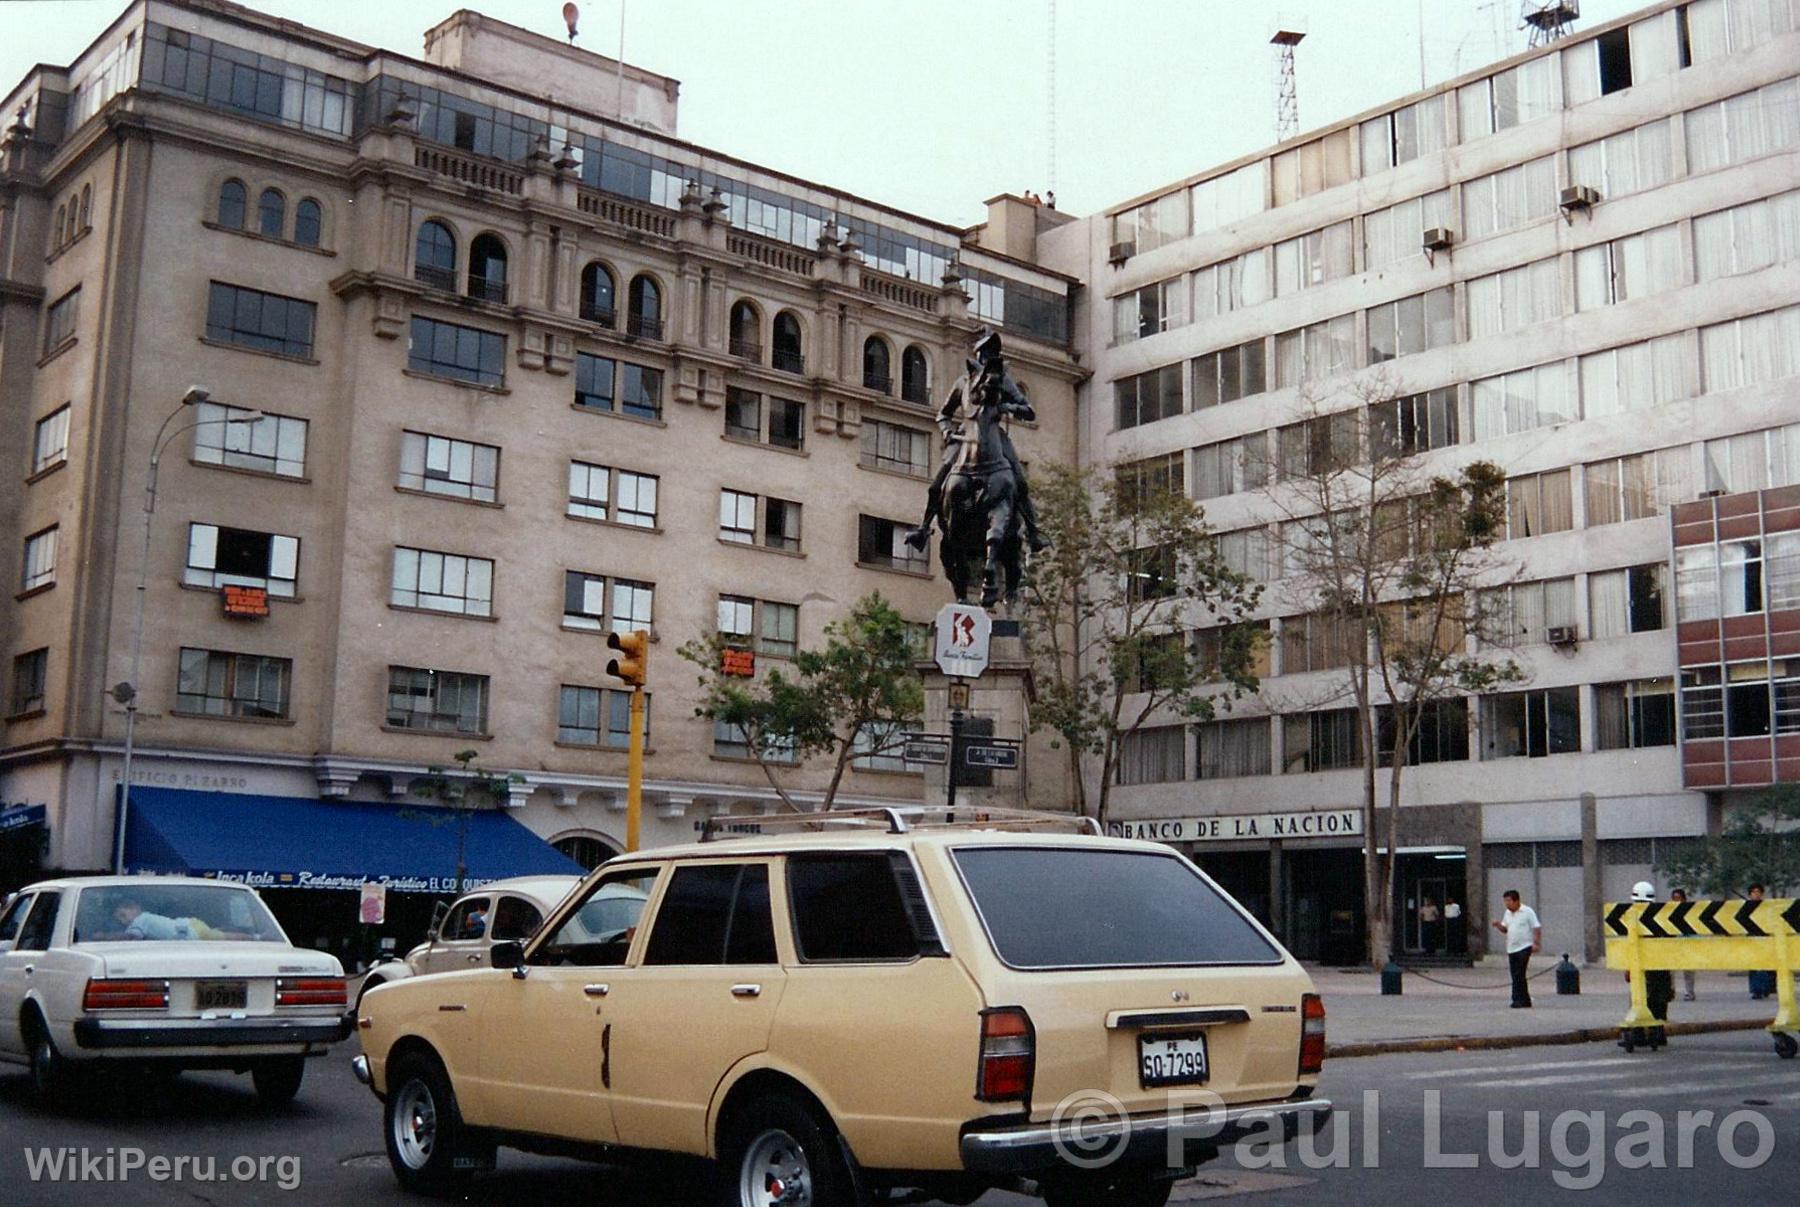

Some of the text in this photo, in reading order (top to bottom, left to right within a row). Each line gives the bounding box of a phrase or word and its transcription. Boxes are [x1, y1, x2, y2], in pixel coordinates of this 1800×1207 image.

[1125, 813, 1355, 839] BANCO DE LA NACION
[216, 870, 245, 884] Inca
[429, 877, 439, 889] EL
[1167, 1042, 1178, 1051] PE
